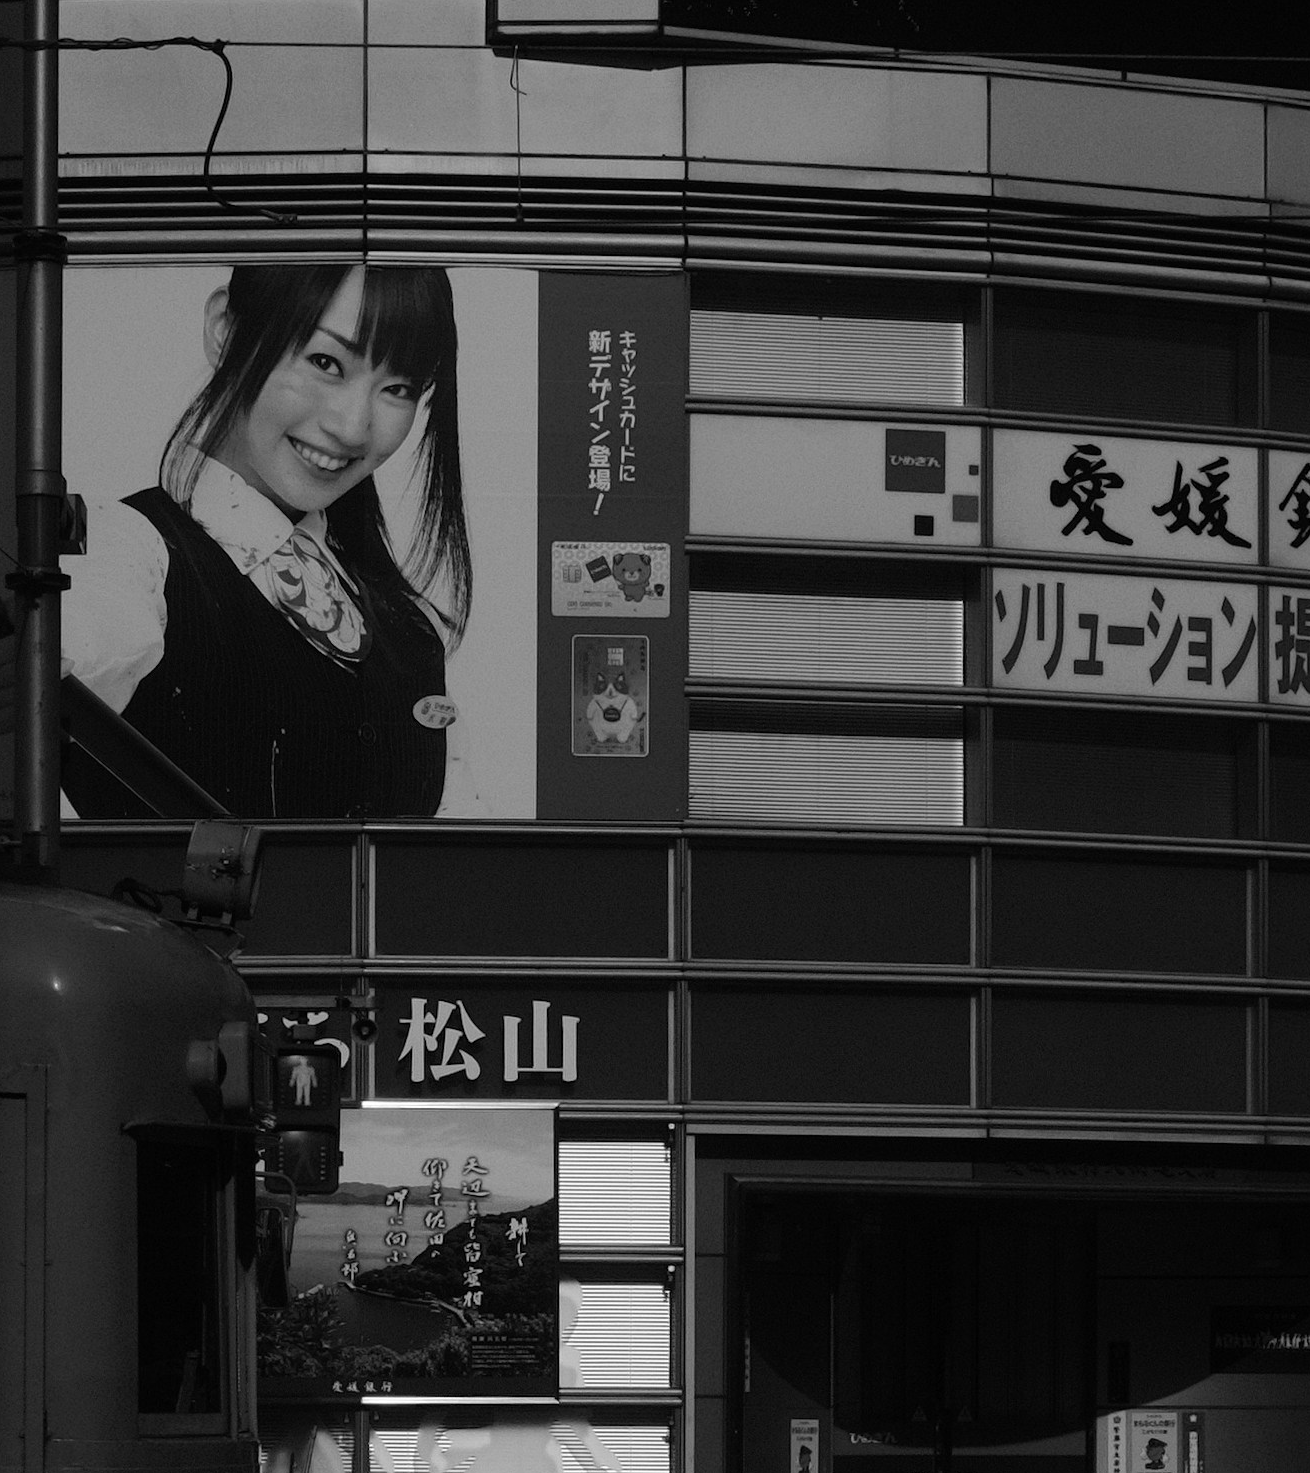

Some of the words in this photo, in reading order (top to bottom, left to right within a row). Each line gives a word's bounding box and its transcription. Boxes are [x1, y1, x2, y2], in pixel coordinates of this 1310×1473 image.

[619, 330, 638, 483] キャッシュカードに
[396, 997, 581, 1084] 松山
